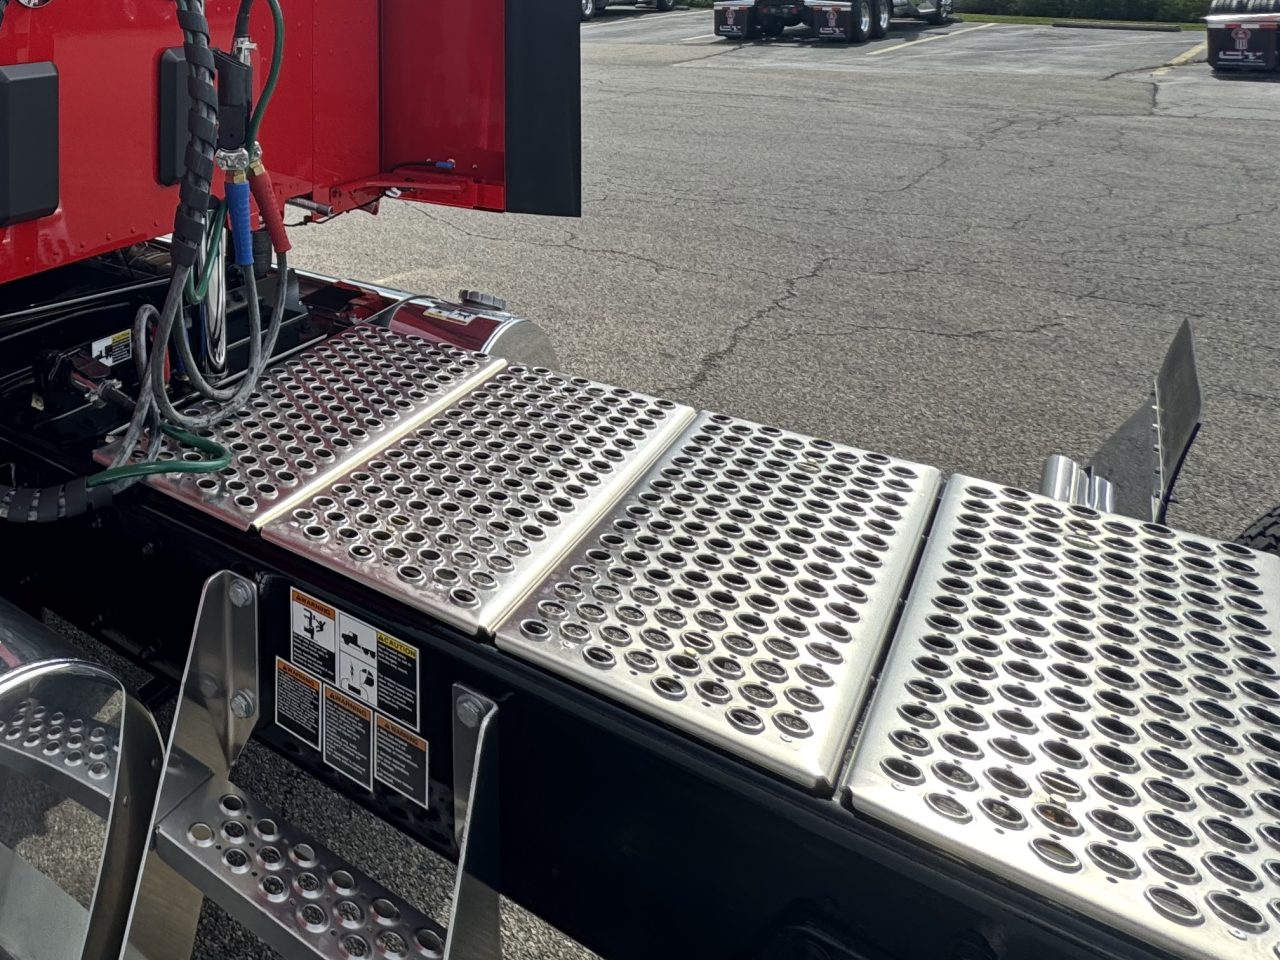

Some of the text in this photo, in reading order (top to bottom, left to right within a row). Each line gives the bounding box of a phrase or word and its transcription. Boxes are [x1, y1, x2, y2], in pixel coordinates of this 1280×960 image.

[301, 596, 331, 616] WARNING
[383, 637, 416, 657] CAUTION
[334, 693, 368, 719] WARNING
